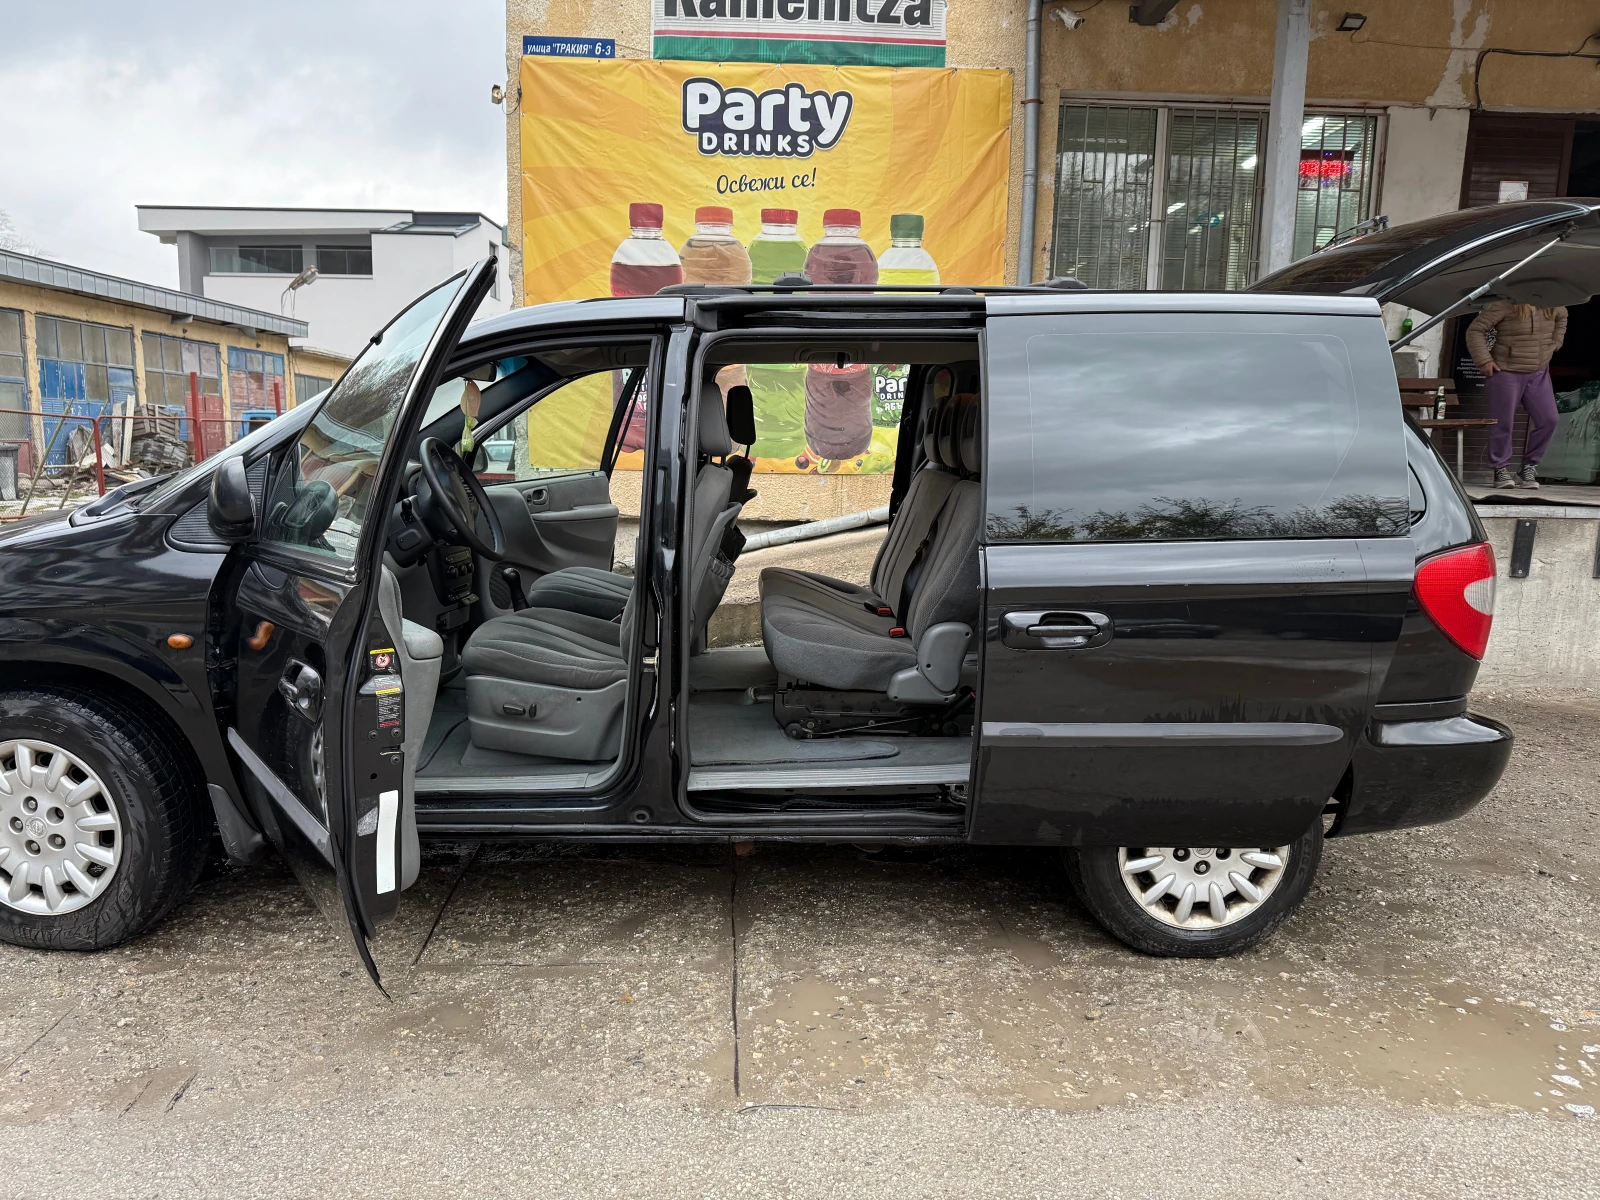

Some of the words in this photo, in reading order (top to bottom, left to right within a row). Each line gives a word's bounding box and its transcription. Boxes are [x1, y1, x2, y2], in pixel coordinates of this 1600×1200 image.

[527, 44, 551, 54] улица
[552, 43, 593, 55] "ТРАКИЯ"
[685, 81, 850, 146] Party
[701, 131, 811, 153] DRINKS
[716, 173, 786, 195] Освежи
[791, 167, 818, 188] се!
[875, 375, 908, 393] Par
[880, 391, 904, 400] DRIN
[884, 402, 903, 411] ЯБЪ
